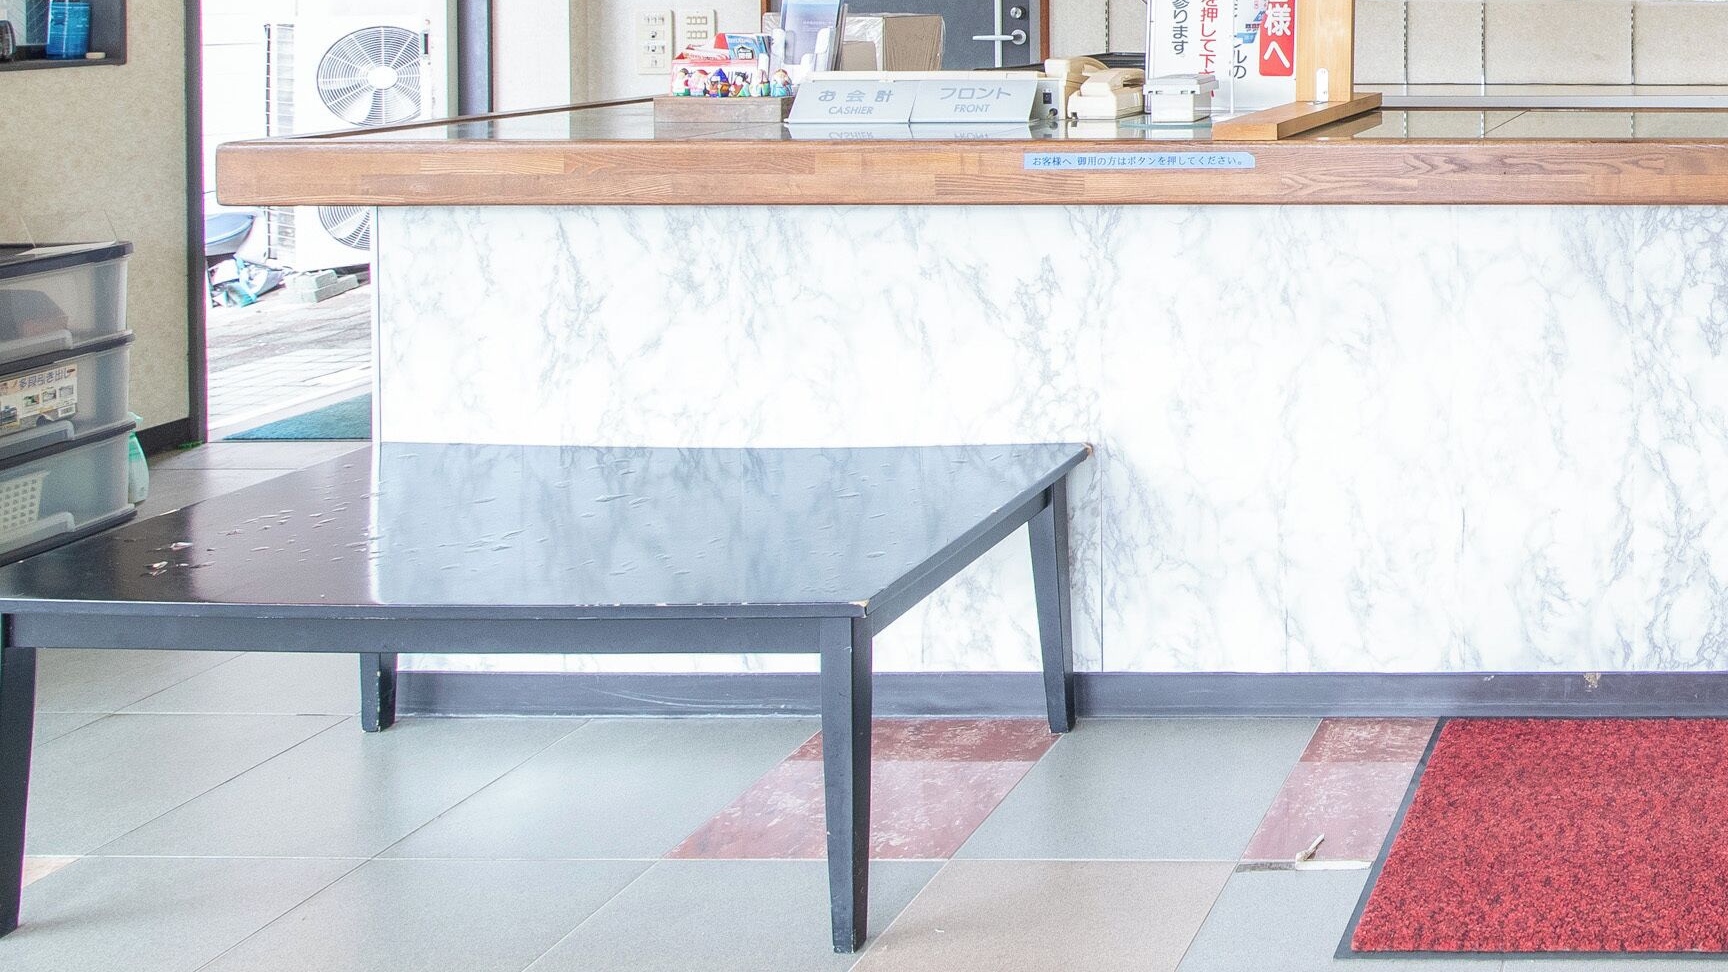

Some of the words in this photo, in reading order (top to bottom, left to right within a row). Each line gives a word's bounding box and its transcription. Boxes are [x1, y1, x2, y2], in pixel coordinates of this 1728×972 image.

[818, 89, 894, 103] お会計
[940, 87, 1011, 101] フロント
[828, 106, 874, 115] CASHIER
[954, 103, 991, 113] FRONT
[1032, 156, 1072, 166] お客様へ
[1077, 156, 1243, 167] 御用の方はボタンを押してください。
